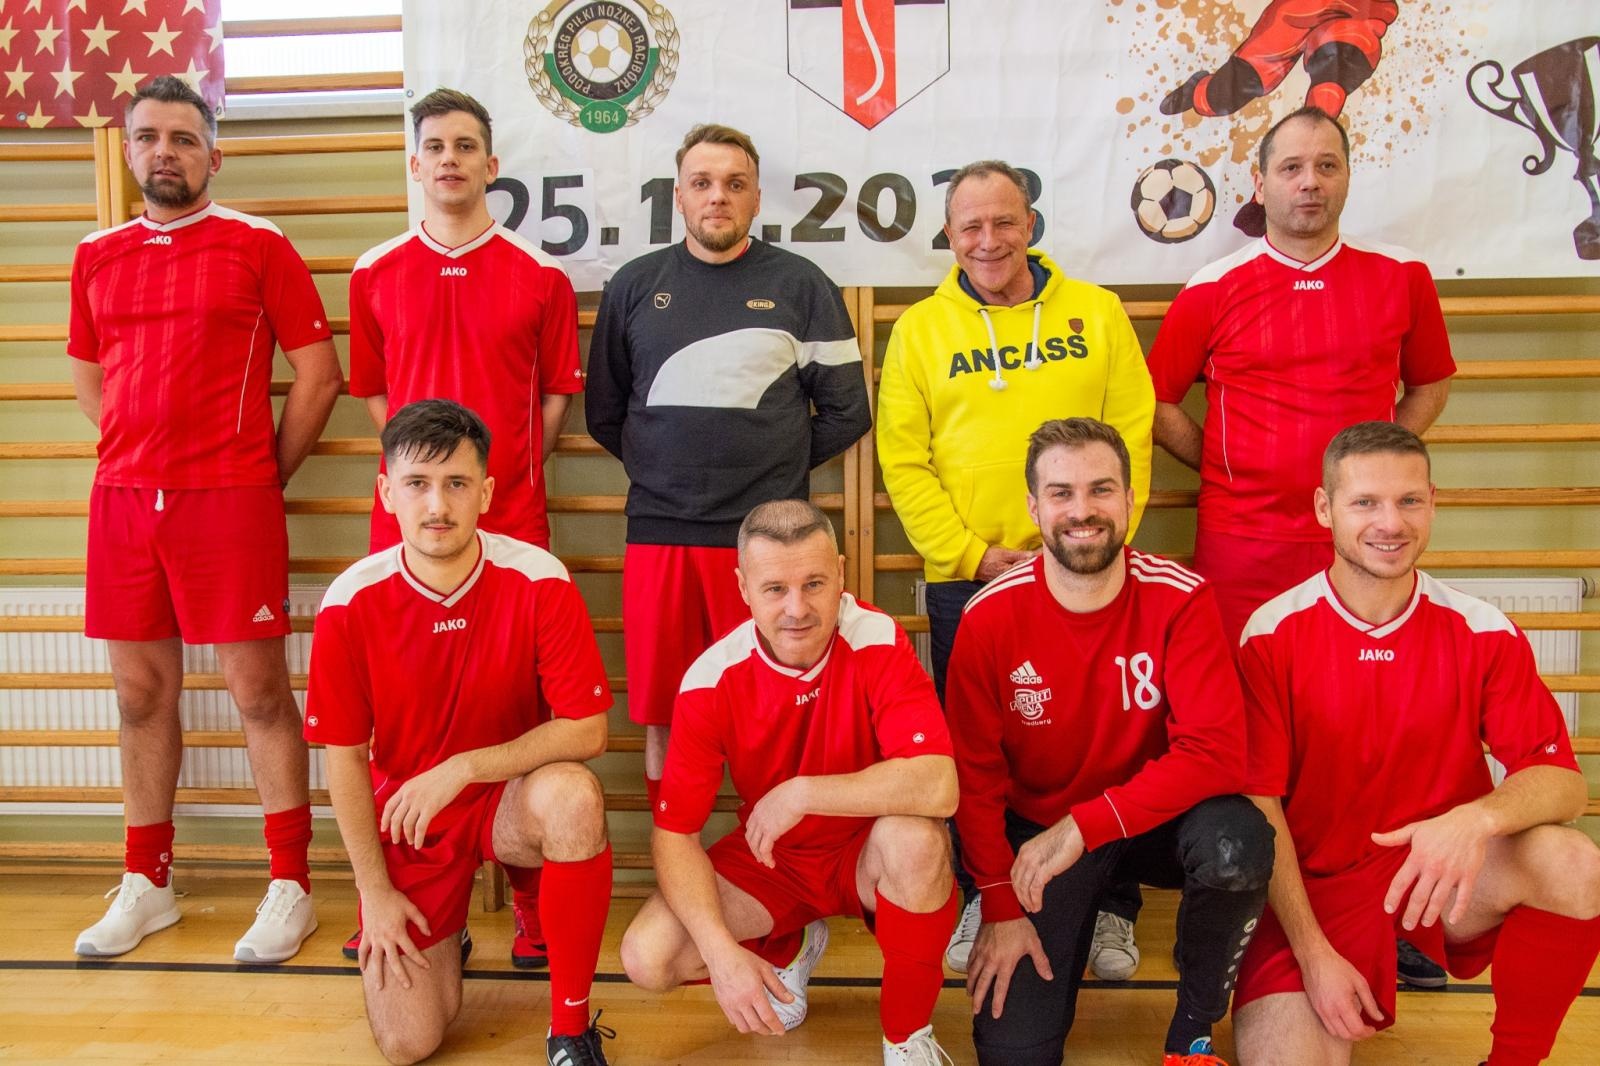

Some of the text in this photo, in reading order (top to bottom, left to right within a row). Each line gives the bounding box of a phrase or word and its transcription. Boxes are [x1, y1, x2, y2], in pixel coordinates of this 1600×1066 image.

[558, 5, 646, 94] PODOKRĘG PIŁKI NOŻNEJ RACIBÓRZ
[586, 110, 620, 124] 1964
[440, 267, 468, 277] JAKO
[1293, 280, 1325, 290] JAKO
[949, 335, 1089, 379] ANCASS
[433, 618, 467, 634] JAKO
[1358, 649, 1395, 661] JAKO
[1010, 674, 1043, 685] adidas
[1115, 652, 1161, 711] 18
